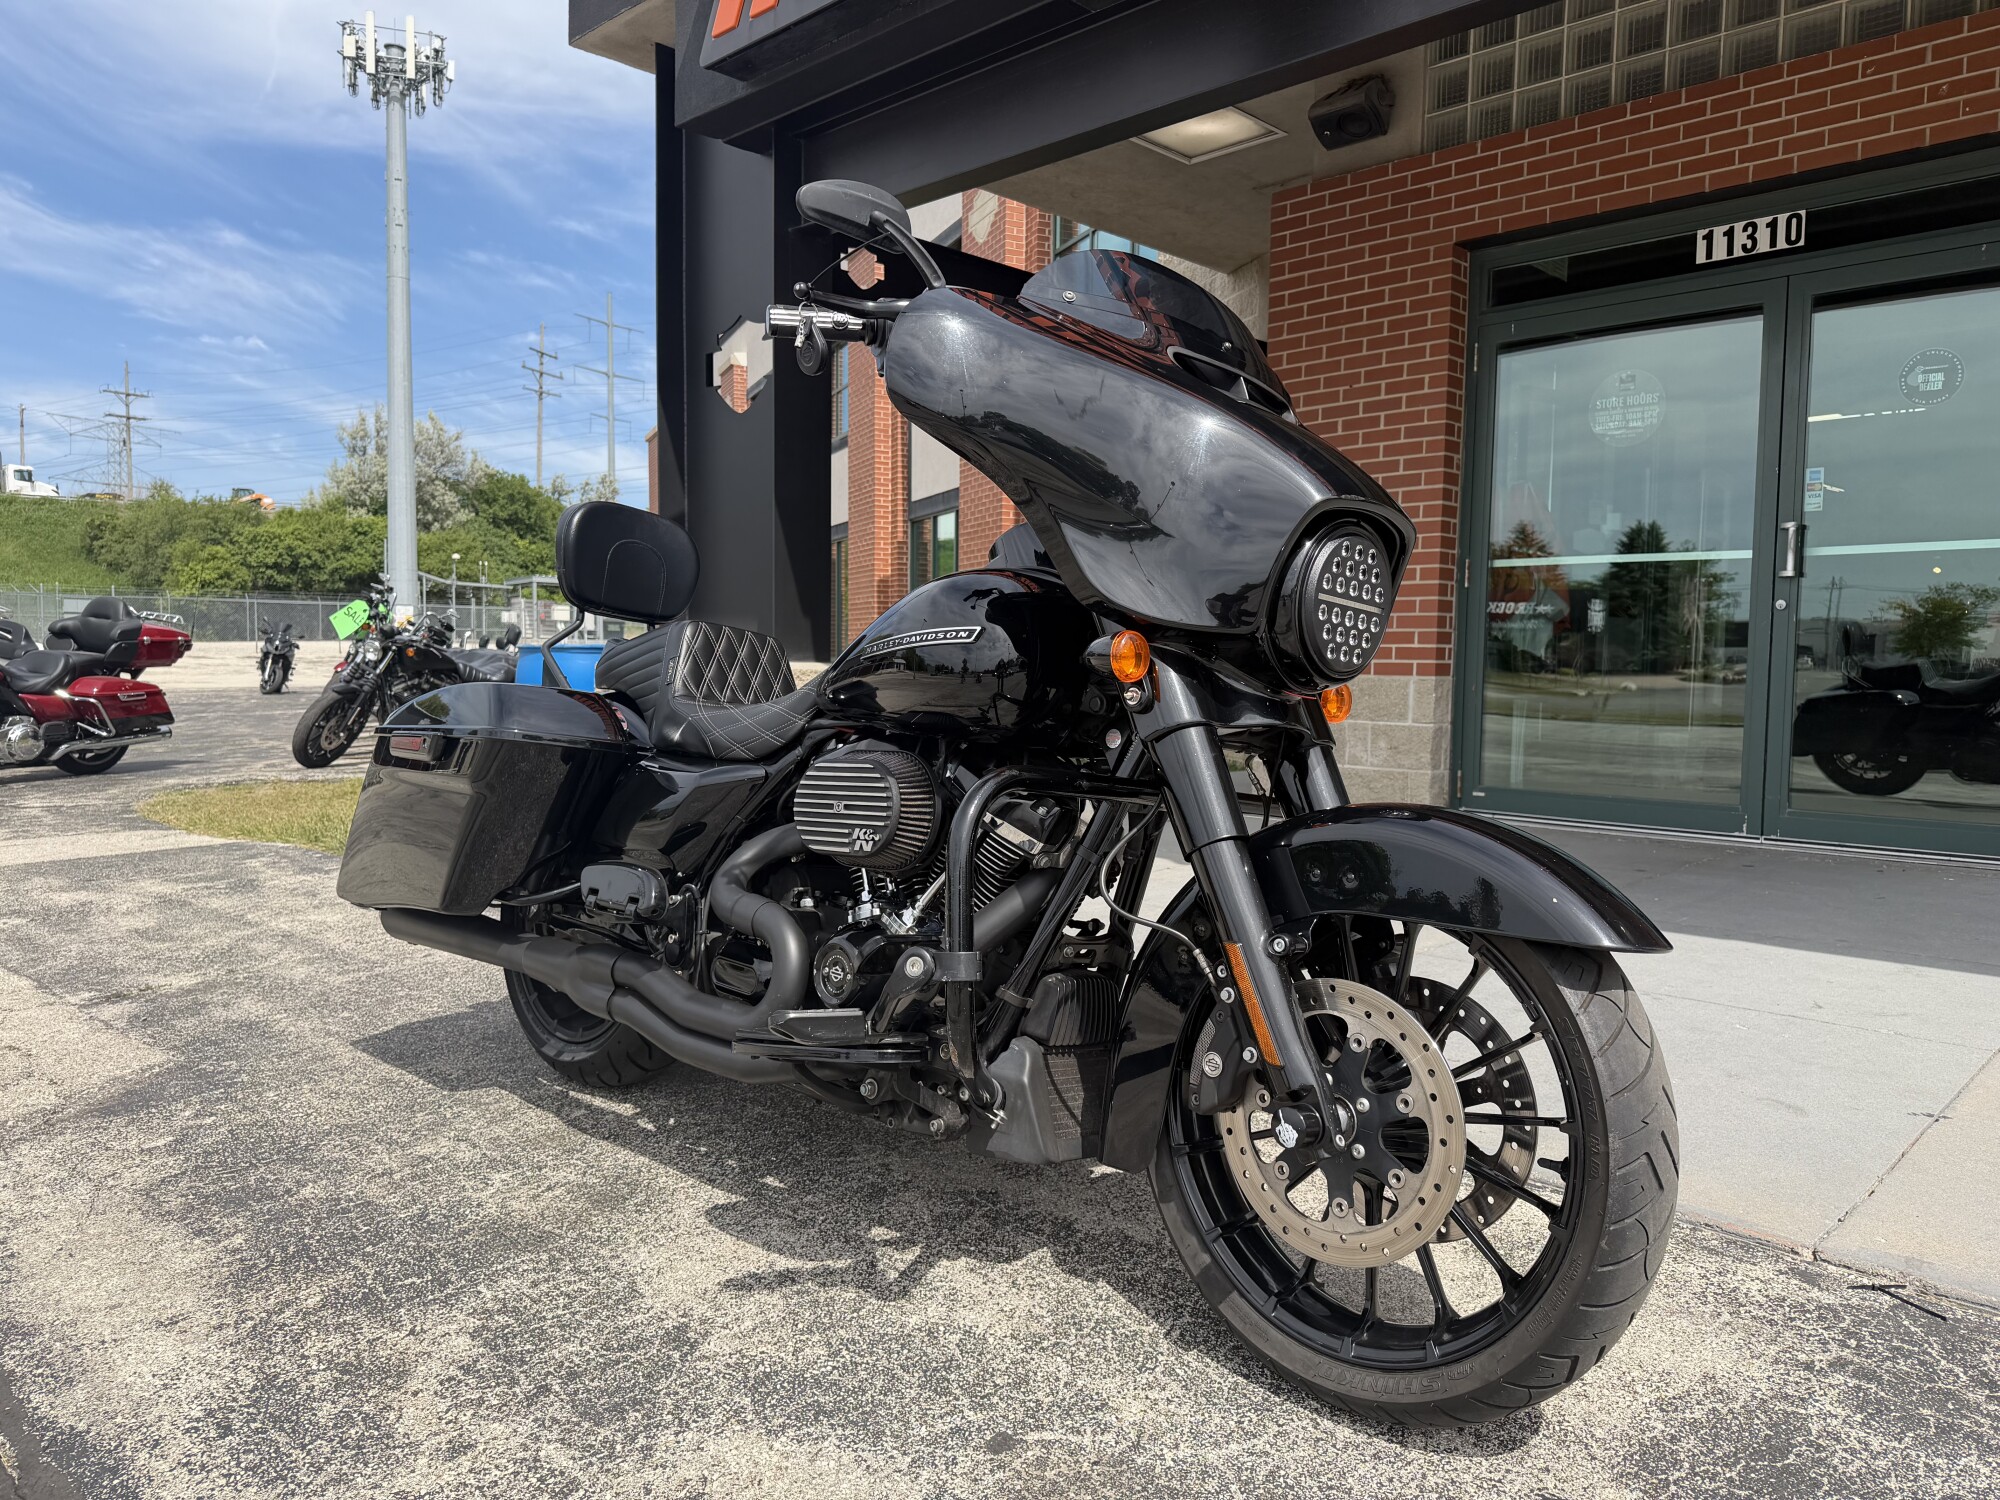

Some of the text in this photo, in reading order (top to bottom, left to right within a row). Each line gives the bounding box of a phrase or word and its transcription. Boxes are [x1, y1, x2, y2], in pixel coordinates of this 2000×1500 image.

[1701, 212, 1803, 260] 11310
[1917, 372, 1945, 383] OFFICIAL
[1919, 381, 1943, 392] DEALER
[1596, 397, 1624, 409] STORE
[865, 631, 969, 654] HARLEY-DAVIDSON
[1317, 1366, 1443, 1395] SHINKO
